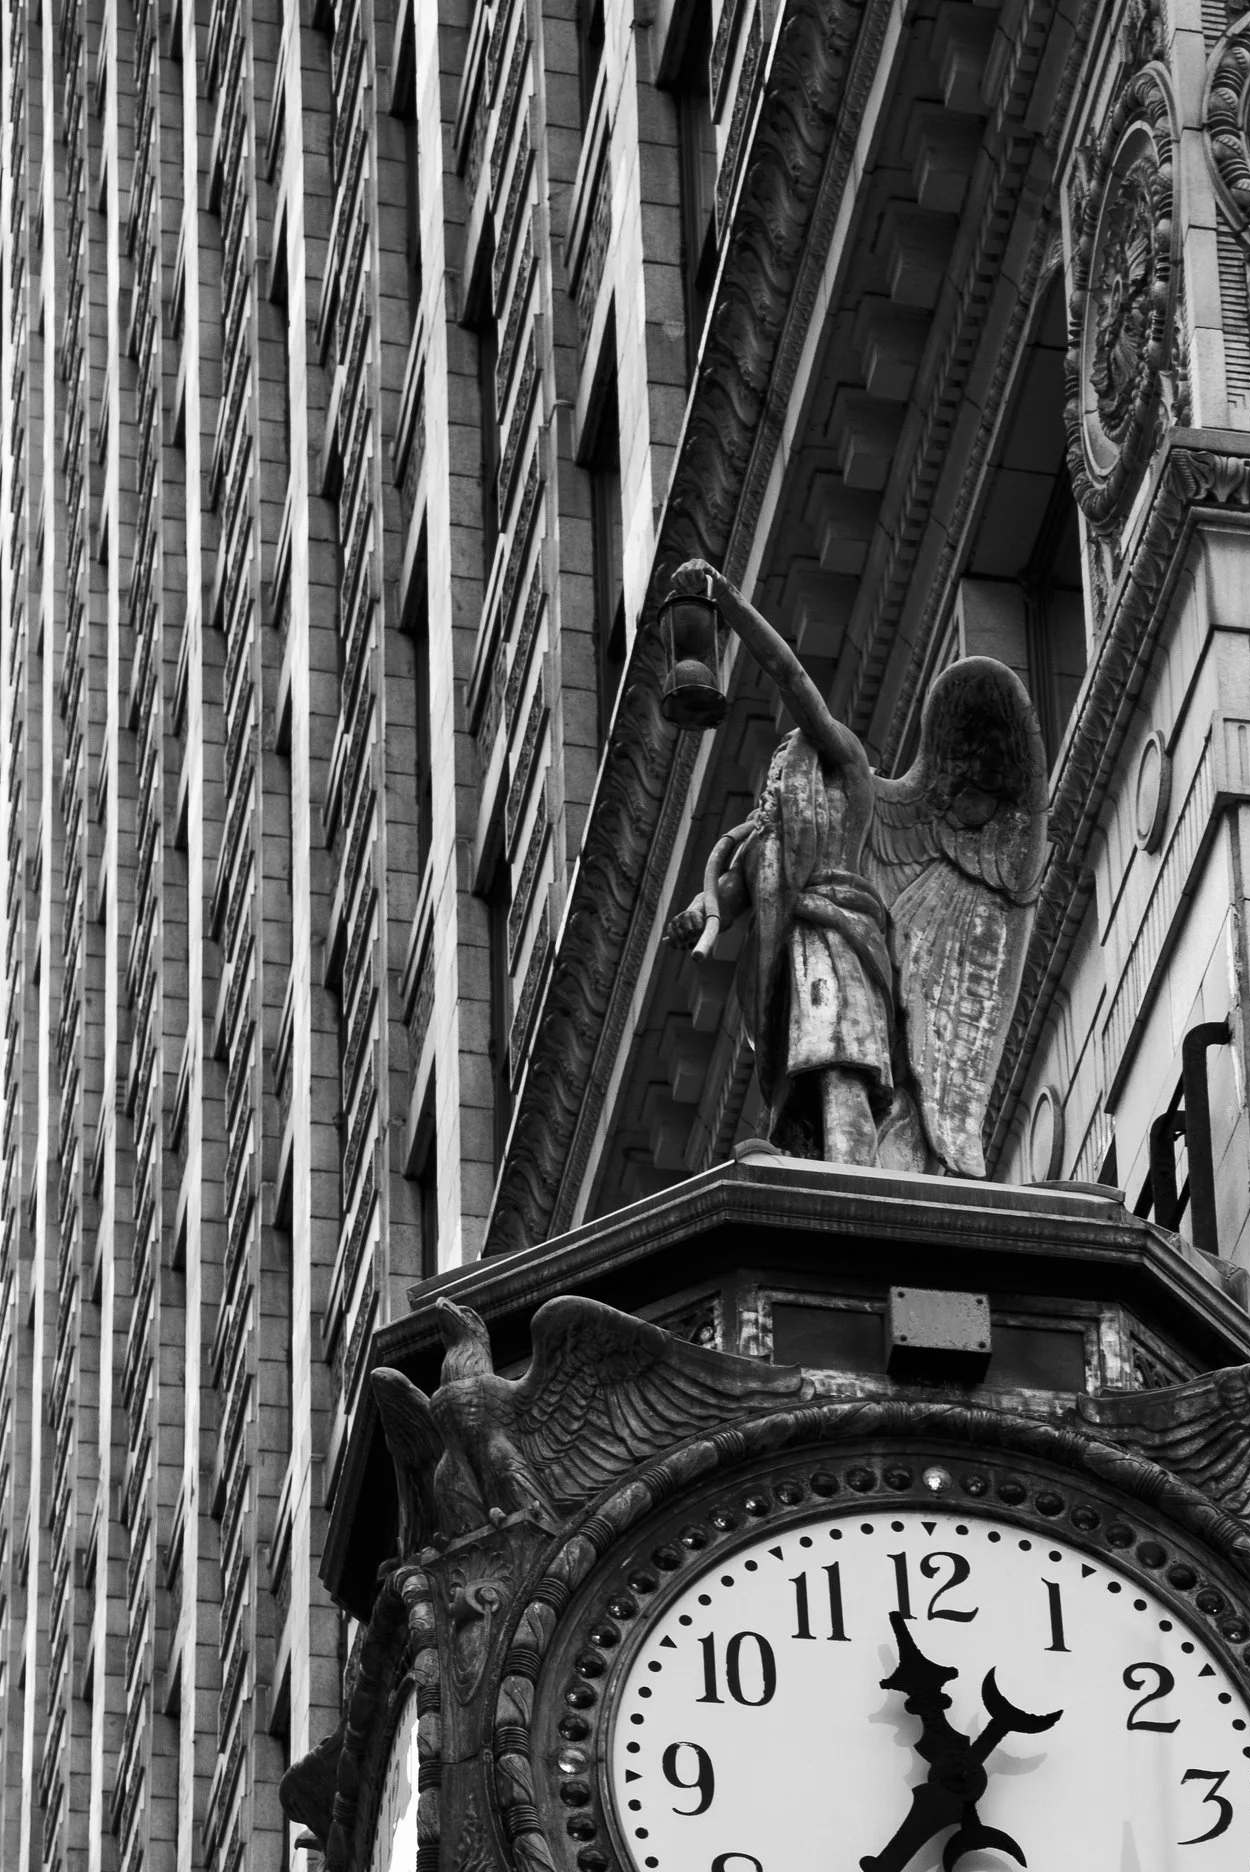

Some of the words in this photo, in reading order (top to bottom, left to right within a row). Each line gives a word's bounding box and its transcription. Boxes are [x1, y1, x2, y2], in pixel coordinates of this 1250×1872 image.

[789, 1561, 851, 1642] 11
[887, 1551, 979, 1622] 12
[1041, 1577, 1072, 1652] 1
[696, 1631, 777, 1706] 10
[1122, 1661, 1181, 1733] 2
[662, 1741, 715, 1816] 9
[1178, 1769, 1234, 1845] 3
